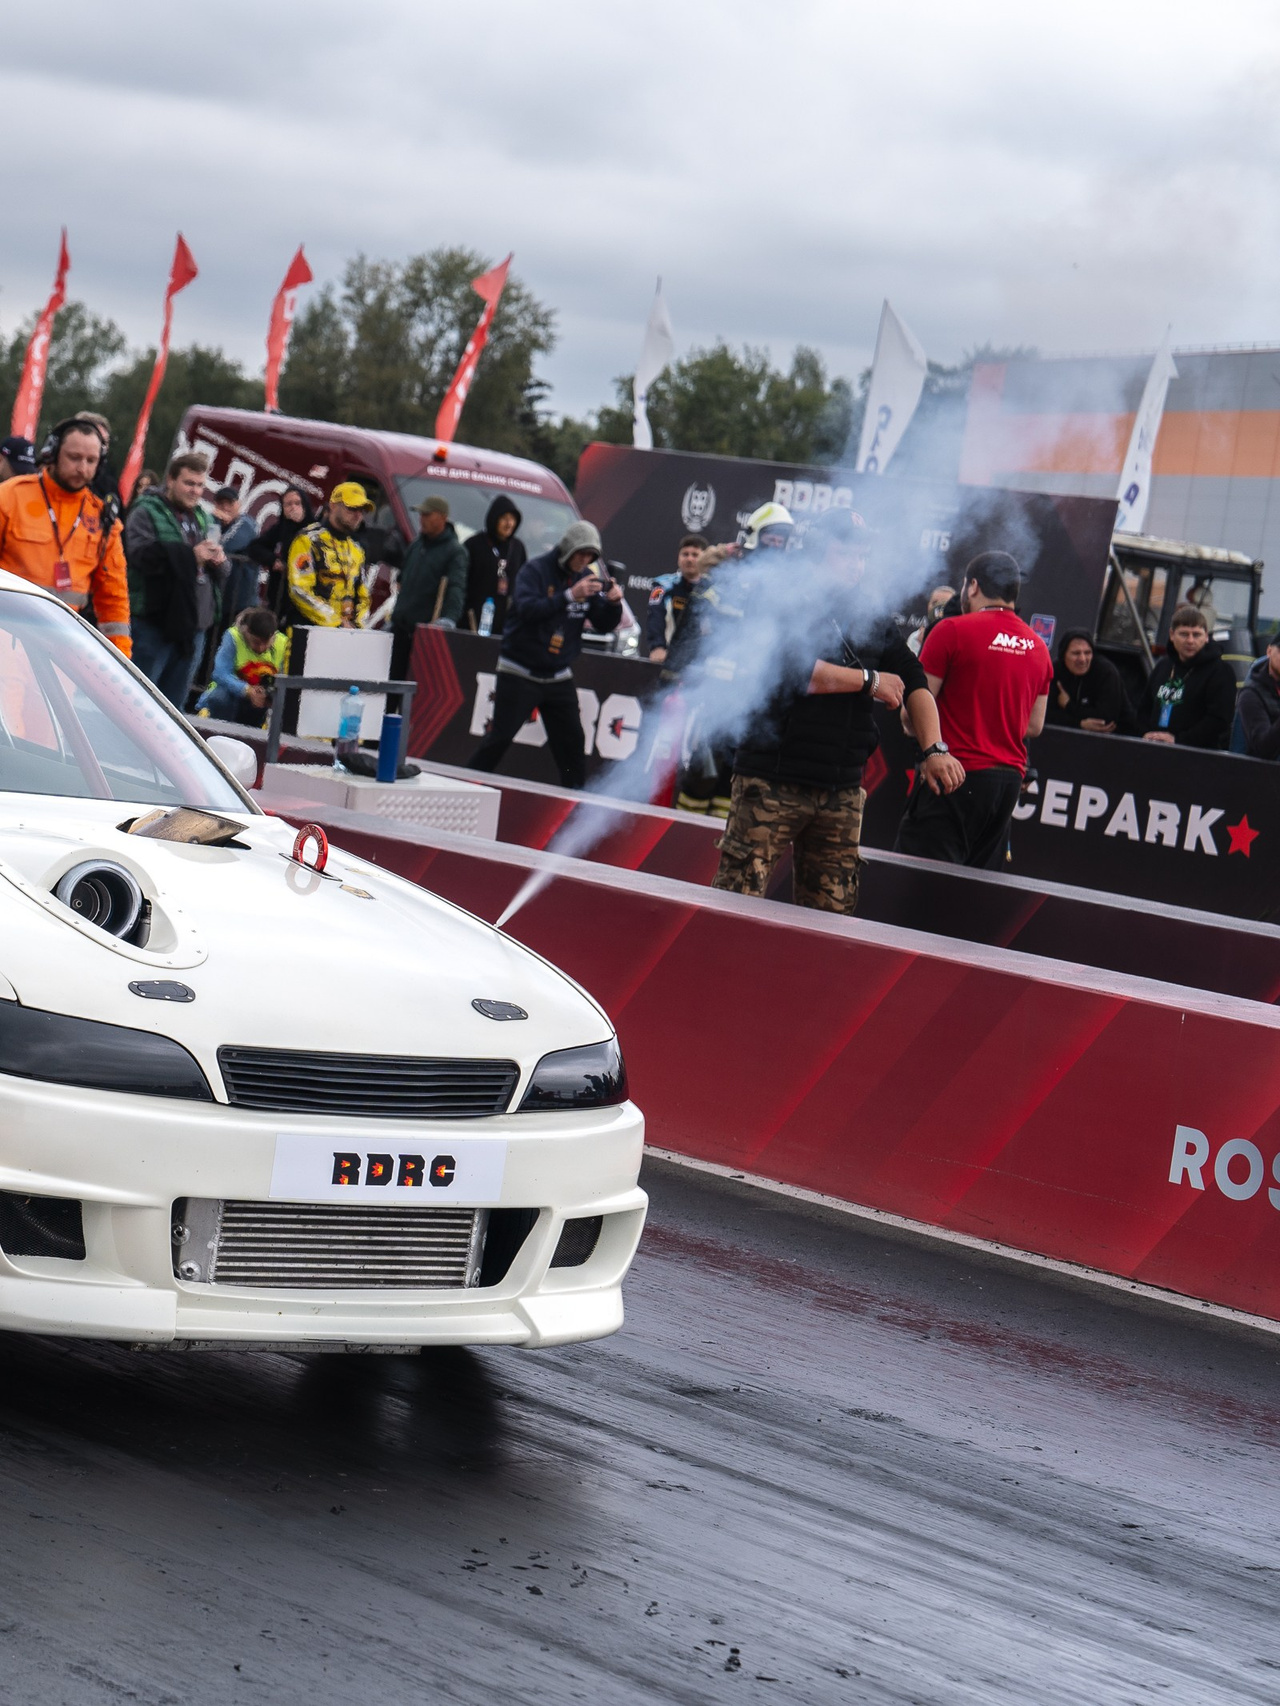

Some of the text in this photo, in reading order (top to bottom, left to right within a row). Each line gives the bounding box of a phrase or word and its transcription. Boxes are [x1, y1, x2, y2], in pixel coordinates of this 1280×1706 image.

[1011, 778, 1225, 856] CEPARK
[332, 1152, 456, 1187] RDRC
[1168, 1124, 1280, 1211] RO
